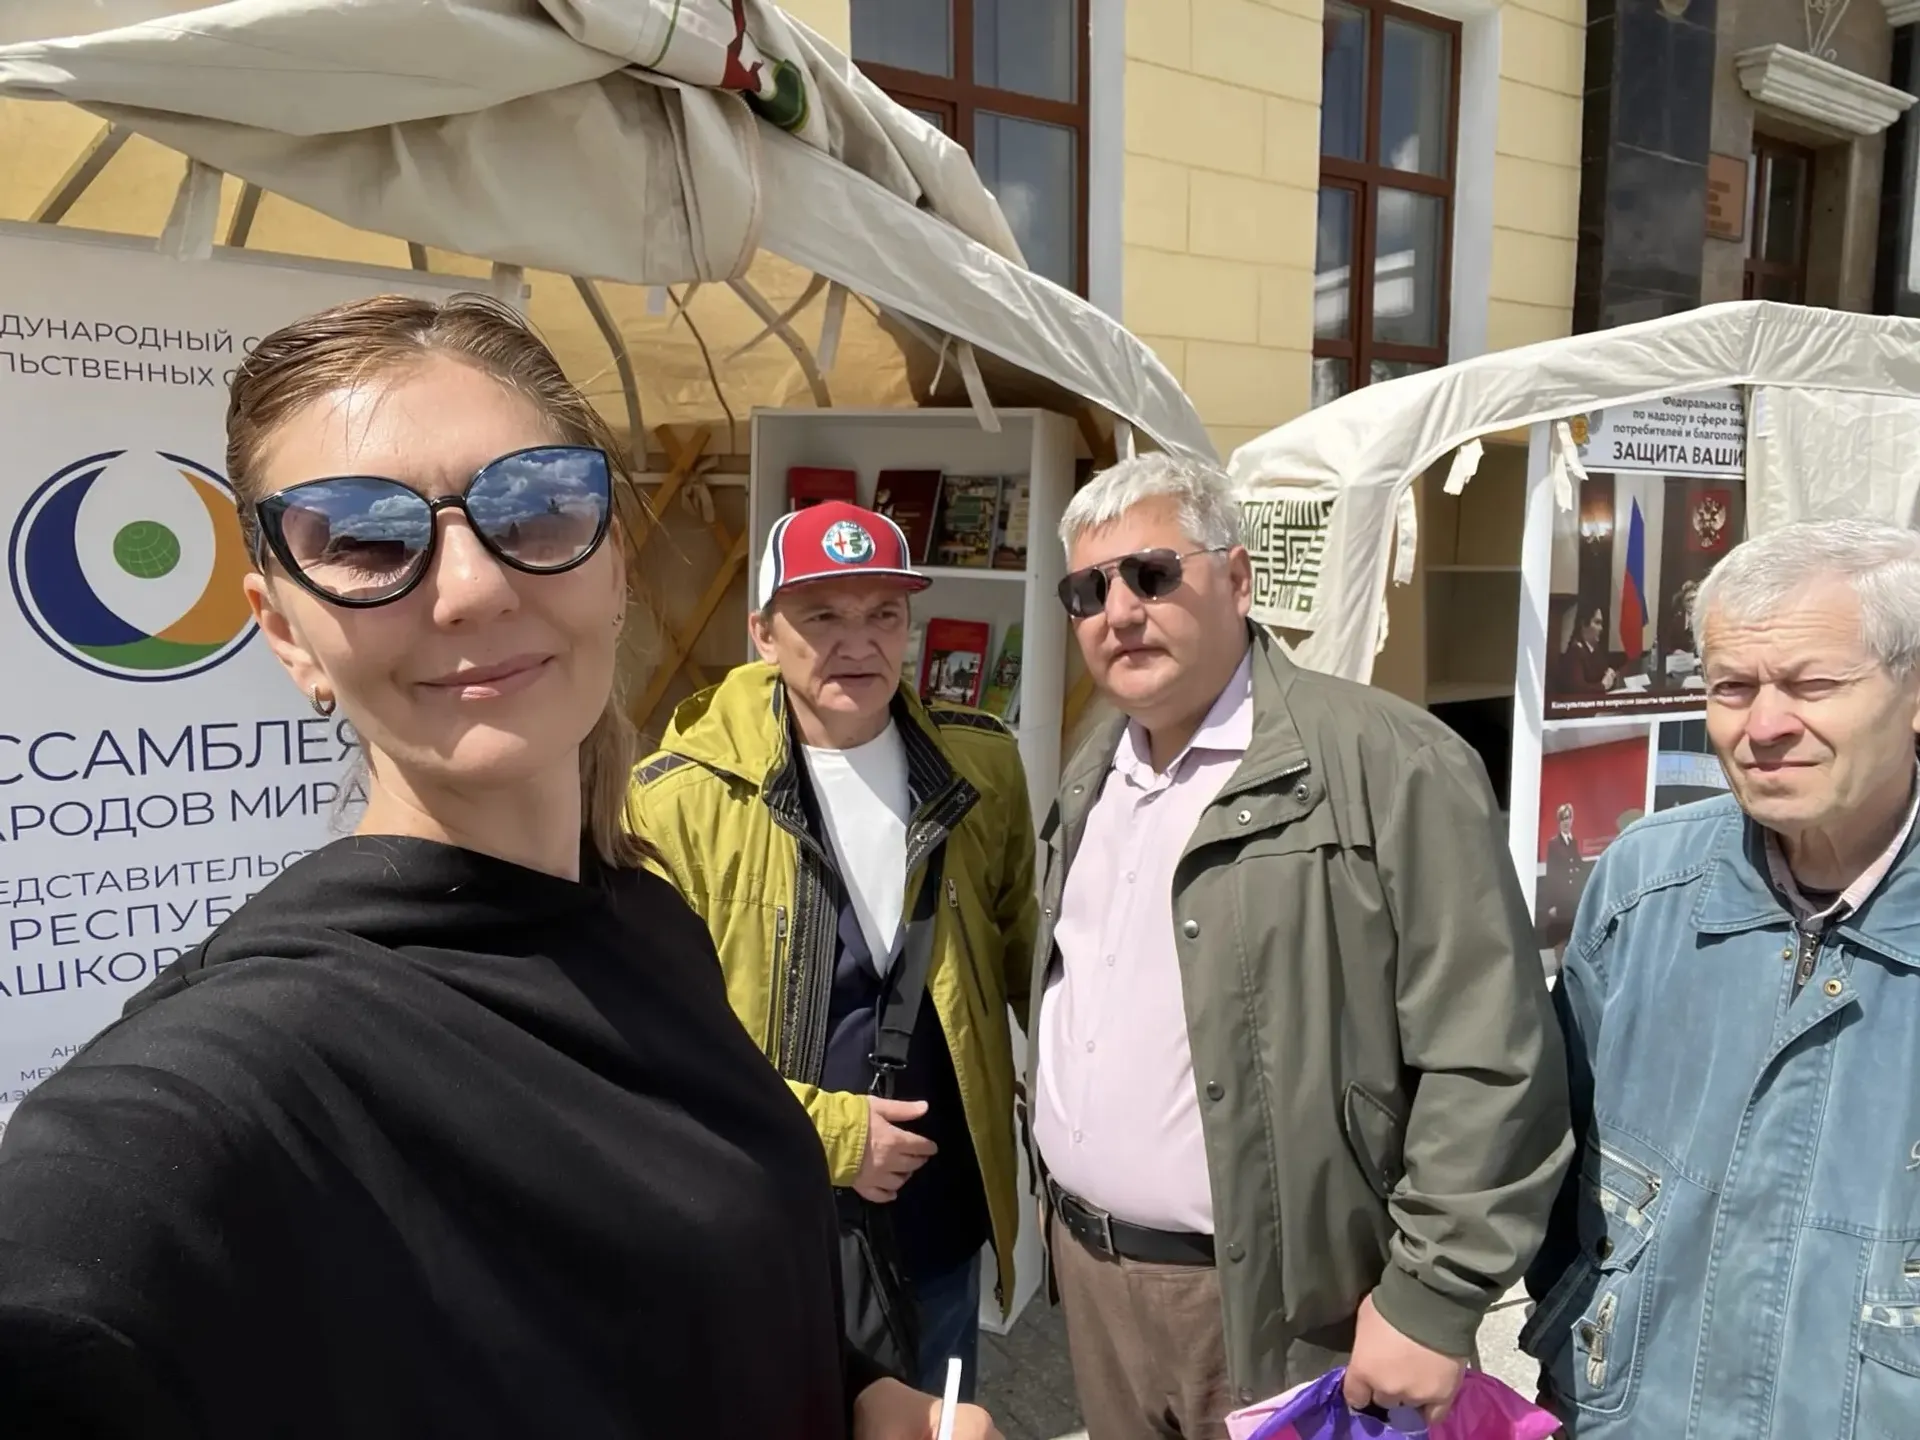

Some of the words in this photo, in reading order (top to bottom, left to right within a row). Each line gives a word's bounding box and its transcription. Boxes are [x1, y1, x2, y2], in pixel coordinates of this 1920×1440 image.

[1662, 396, 1727, 411] Федеральная
[1633, 409, 1645, 420] по
[1648, 411, 1687, 426] надзору
[1697, 413, 1727, 428] сфере
[1613, 424, 1683, 438] потребителей
[1694, 427, 1746, 444] благополу
[1613, 440, 1688, 465] ЗАЩИТА
[1692, 446, 1746, 468] ВАШИ
[0, 791, 215, 841] РОДОВ
[231, 780, 369, 822] МИРА
[10, 893, 257, 951] РЕСПУБ
[0, 943, 201, 998] ШКОР
